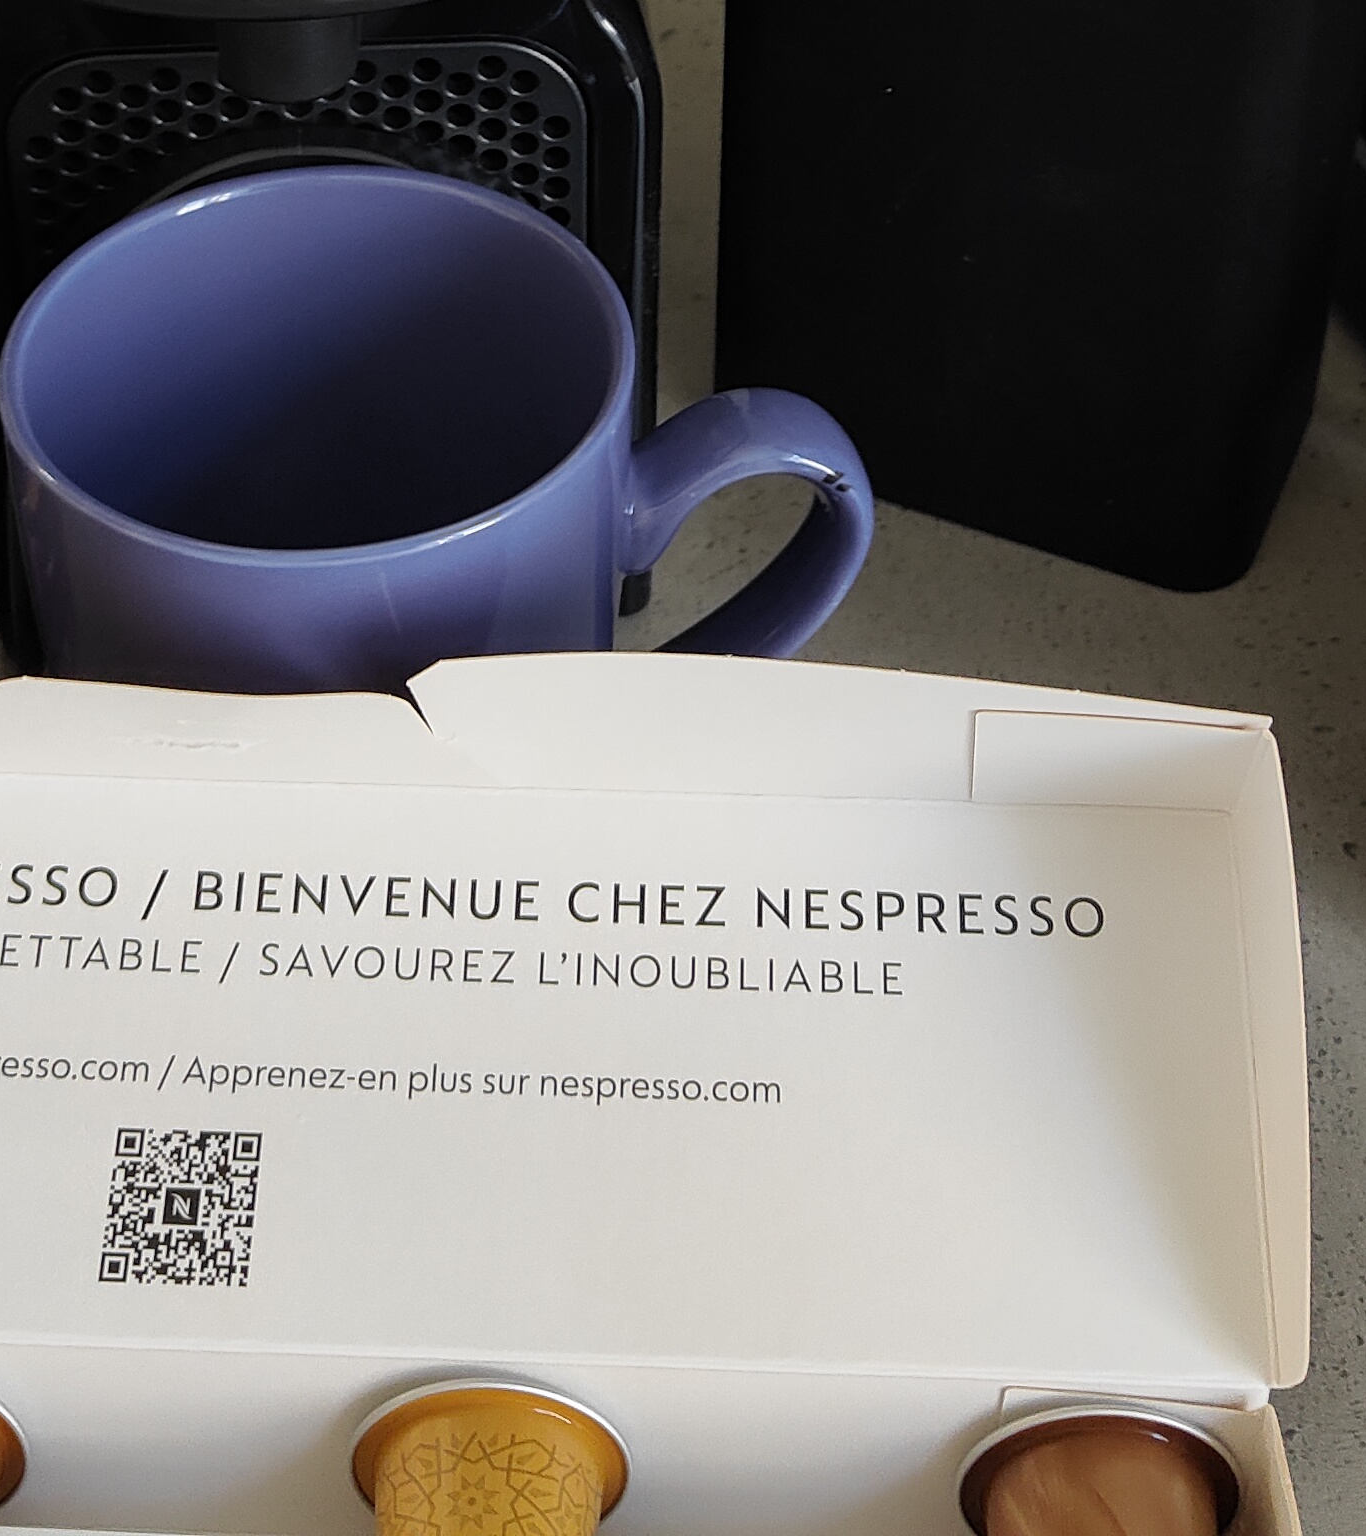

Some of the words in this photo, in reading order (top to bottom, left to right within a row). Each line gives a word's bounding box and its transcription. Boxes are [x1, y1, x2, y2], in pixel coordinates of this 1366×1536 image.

[140, 868, 170, 922] /
[193, 870, 541, 922] BIENVENUE
[567, 881, 727, 927] CHEZ
[755, 887, 1106, 939] NESPRESSO
[218, 941, 241, 985] /
[259, 942, 516, 985] SAVOUREZ
[156, 1054, 177, 1092] /
[181, 1055, 398, 1095] Apprenez-en
[407, 1062, 473, 1101] plus
[482, 1073, 531, 1096] sur
[540, 1073, 782, 1107] nespresso.com
